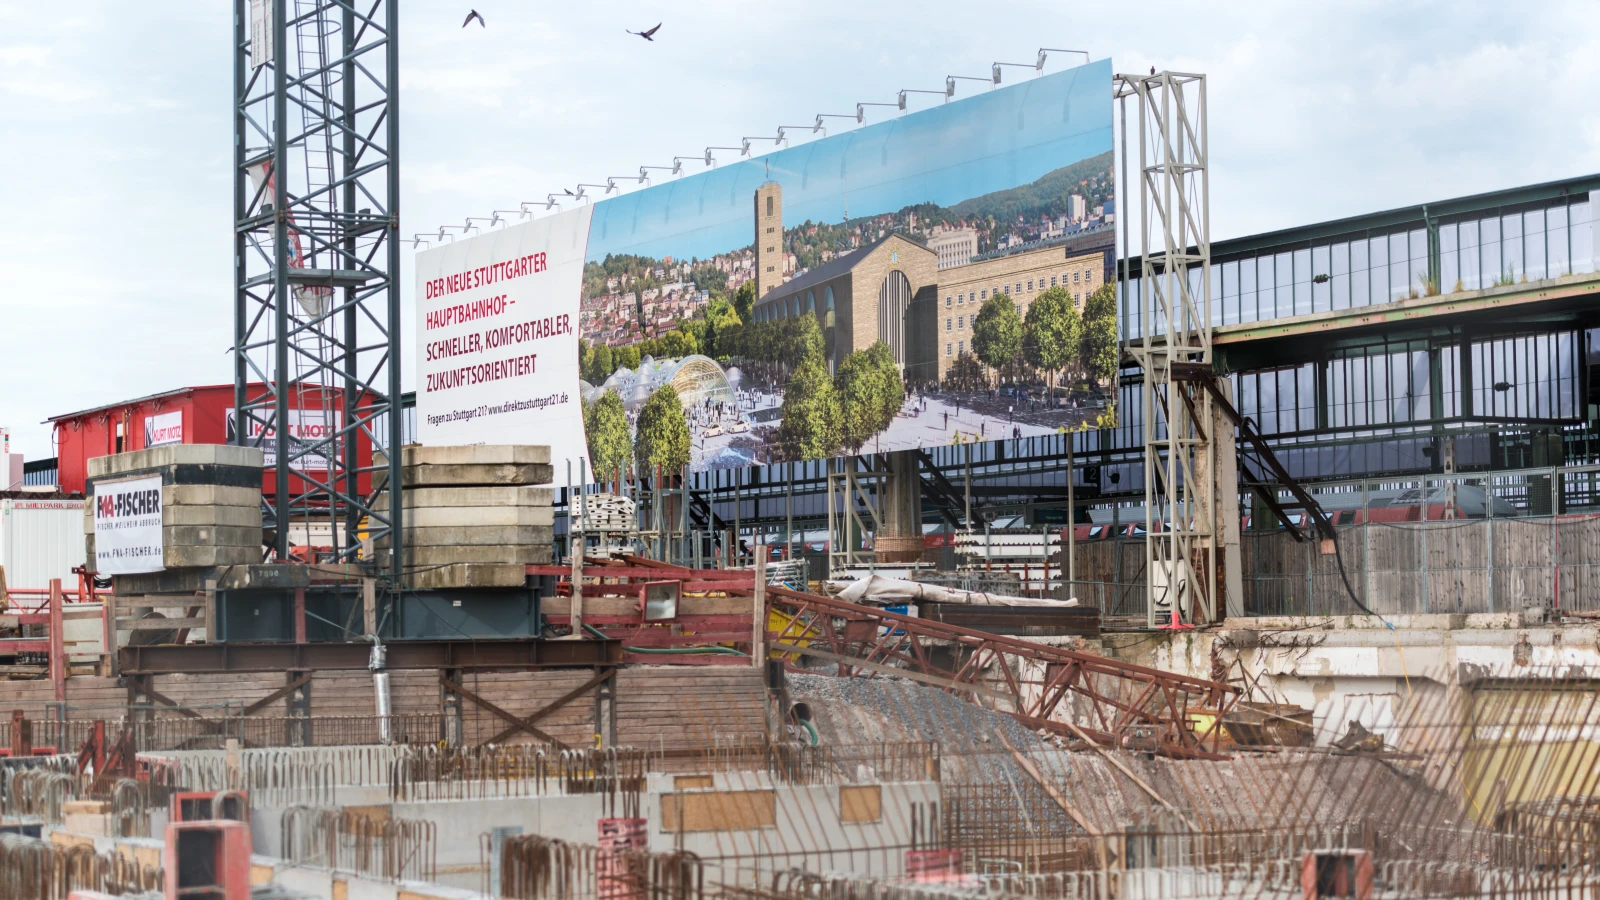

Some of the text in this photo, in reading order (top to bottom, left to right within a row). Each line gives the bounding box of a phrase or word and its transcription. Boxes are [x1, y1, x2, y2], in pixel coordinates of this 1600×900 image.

[426, 251, 547, 299] DER NEUE STUTTGARTER
[426, 294, 507, 330] HAUPTBAHNHOF
[426, 314, 572, 362] SCHNELLER, KOMFORTABLER,
[426, 354, 537, 393] ZUKUNFTSORIENTIERT
[427, 392, 568, 427] Fragen zu Stuttgart 21? www.direktzustuttgart21.de
[153, 425, 181, 442] KURT MOTZ
[255, 424, 293, 437] KUT
[1090, 467, 1097, 480] 2
[97, 518, 161, 531] FISCHER WEILHEIM ABBRUCH
